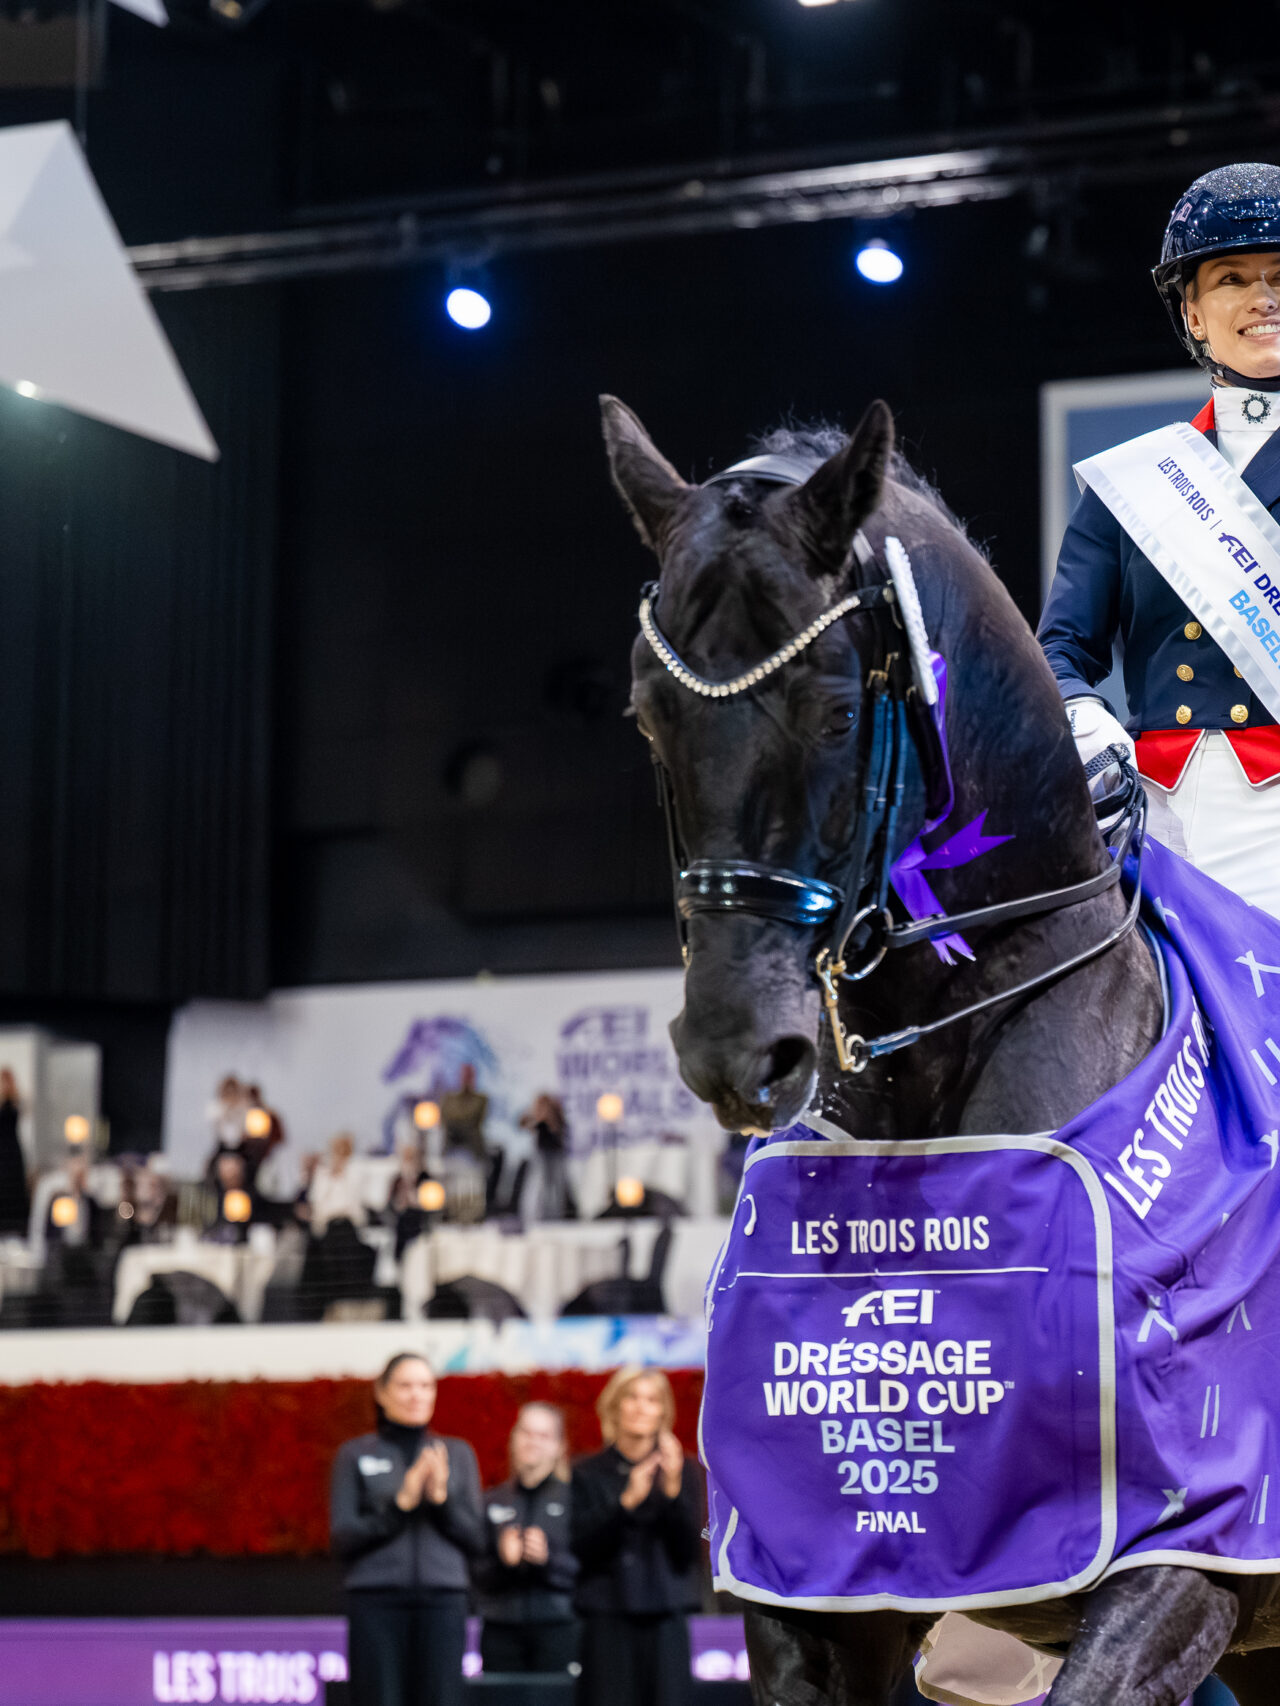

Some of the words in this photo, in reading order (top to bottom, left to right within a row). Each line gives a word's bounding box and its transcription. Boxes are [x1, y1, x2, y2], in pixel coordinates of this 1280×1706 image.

[1158, 456, 1178, 475] LES
[1168, 468, 1195, 497] TROIS
[1186, 490, 1215, 521] ROIS
[1103, 1128, 1172, 1220] LES
[1144, 1035, 1205, 1150] TROIS
[791, 1220, 839, 1255] LES
[846, 1219, 915, 1254] TROIS
[924, 1216, 990, 1252] ROIS
[773, 1338, 992, 1377] DRESSAGE
[763, 1378, 910, 1416] WORLD
[820, 1418, 956, 1454] BASEL
[837, 1459, 939, 1495] 2025
[855, 1511, 926, 1534] FINAL
[153, 1651, 216, 1703] LES
[217, 1651, 317, 1704] TROIS
